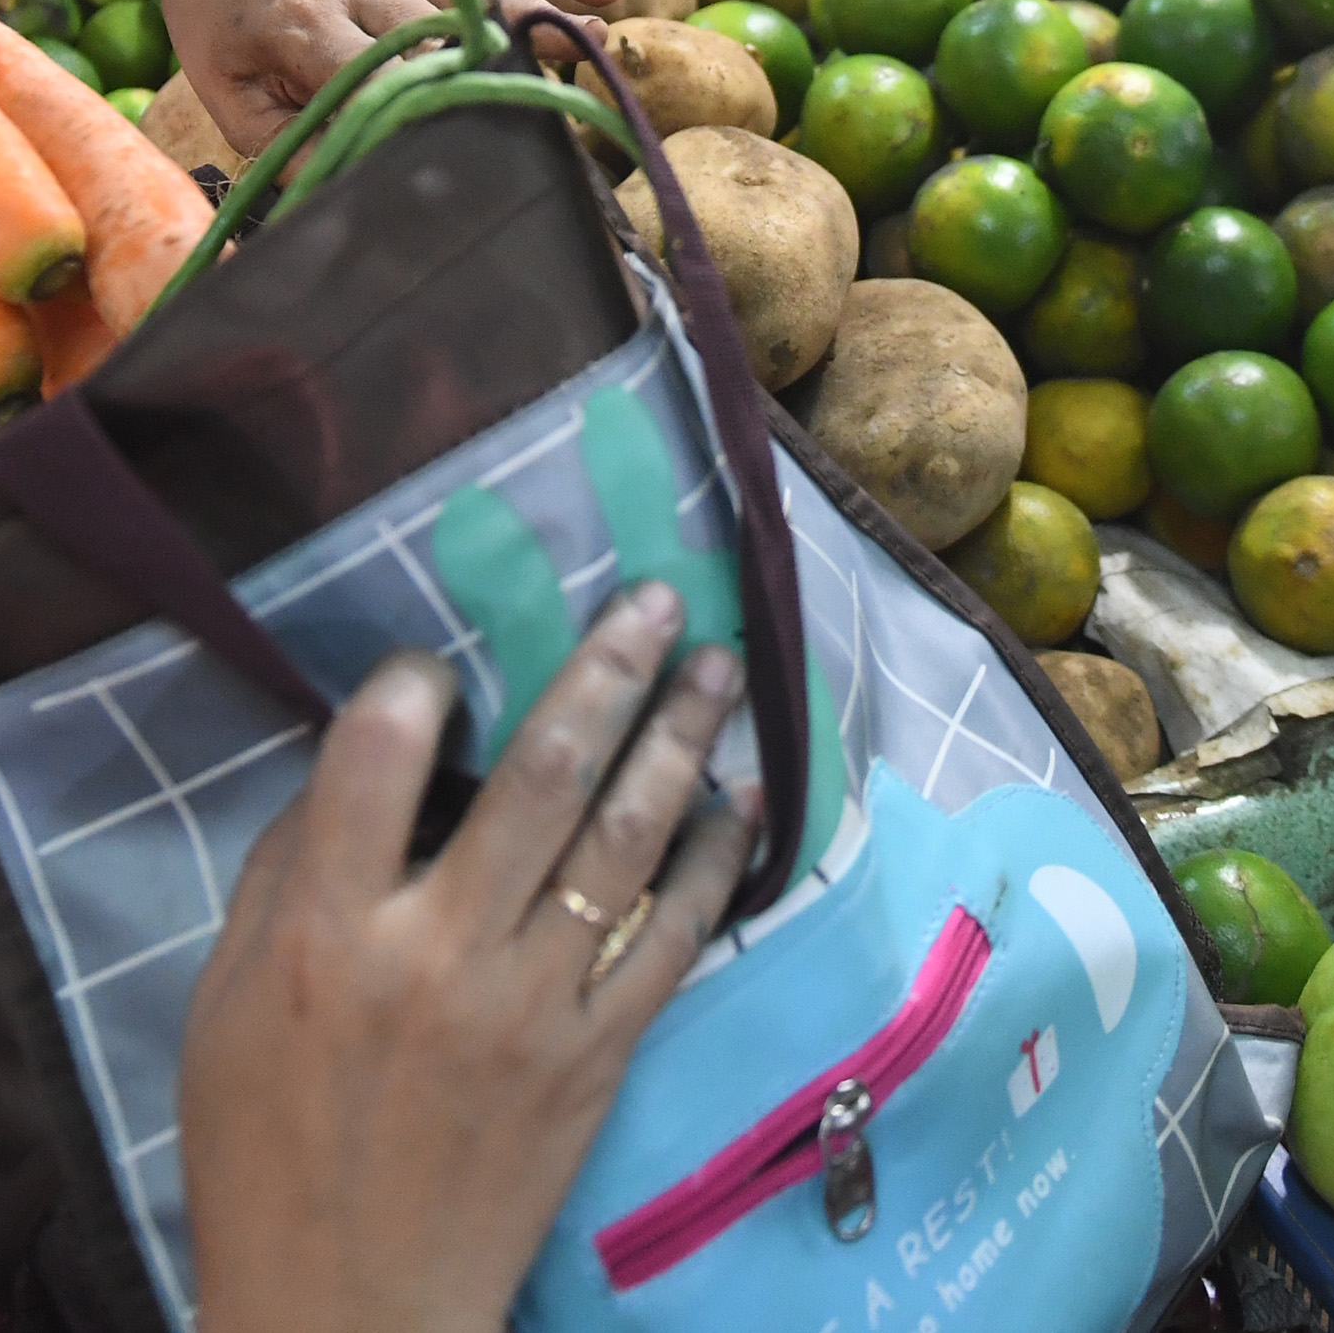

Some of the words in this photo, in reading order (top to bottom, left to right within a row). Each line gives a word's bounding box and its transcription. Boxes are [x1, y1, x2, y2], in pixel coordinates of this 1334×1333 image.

[867, 1277, 895, 1331] A
[896, 1127, 1015, 1280] REST!
[935, 1219, 1015, 1313] home
